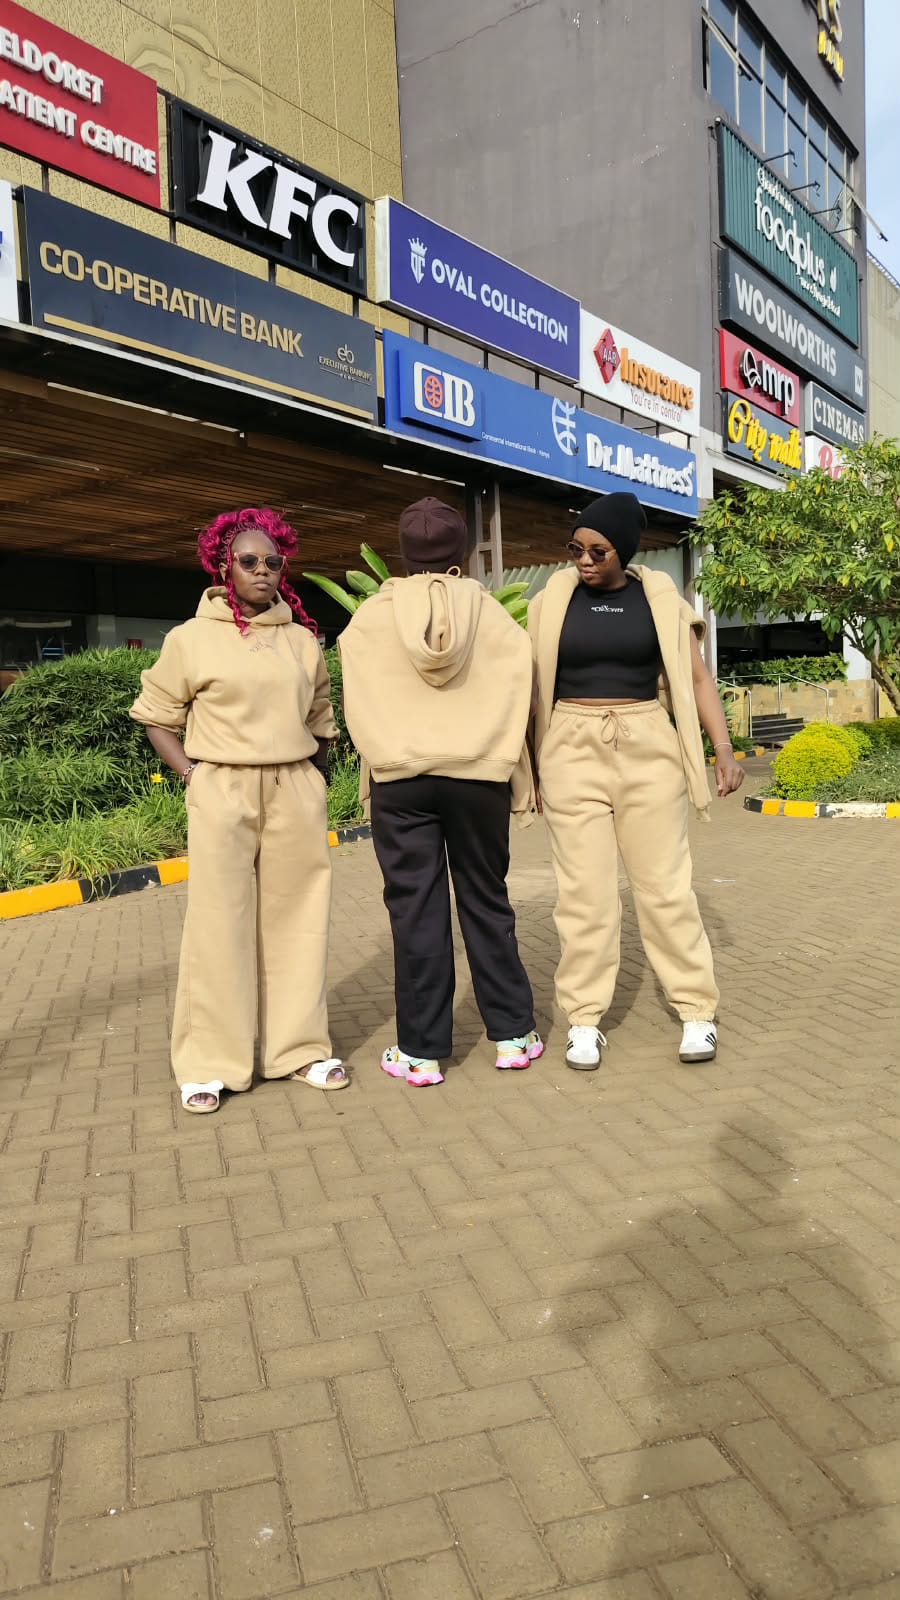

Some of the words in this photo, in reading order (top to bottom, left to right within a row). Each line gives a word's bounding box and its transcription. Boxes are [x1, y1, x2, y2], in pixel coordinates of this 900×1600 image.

[0, 26, 104, 105] ELDORET
[80, 120, 157, 176] CENTRE
[197, 129, 360, 268] KFC
[39, 241, 237, 335] CO-OPERATIVE
[240, 311, 304, 359] BANK
[431, 258, 477, 301] OVAL
[480, 283, 568, 345] COLLECTION
[735, 271, 837, 377] WOOLWORTHS
[603, 347, 617, 365] AAR
[620, 347, 695, 411] Insurance
[762, 360, 795, 416] mrp
[413, 361, 476, 427] CIB
[813, 396, 865, 443] CINEMAS
